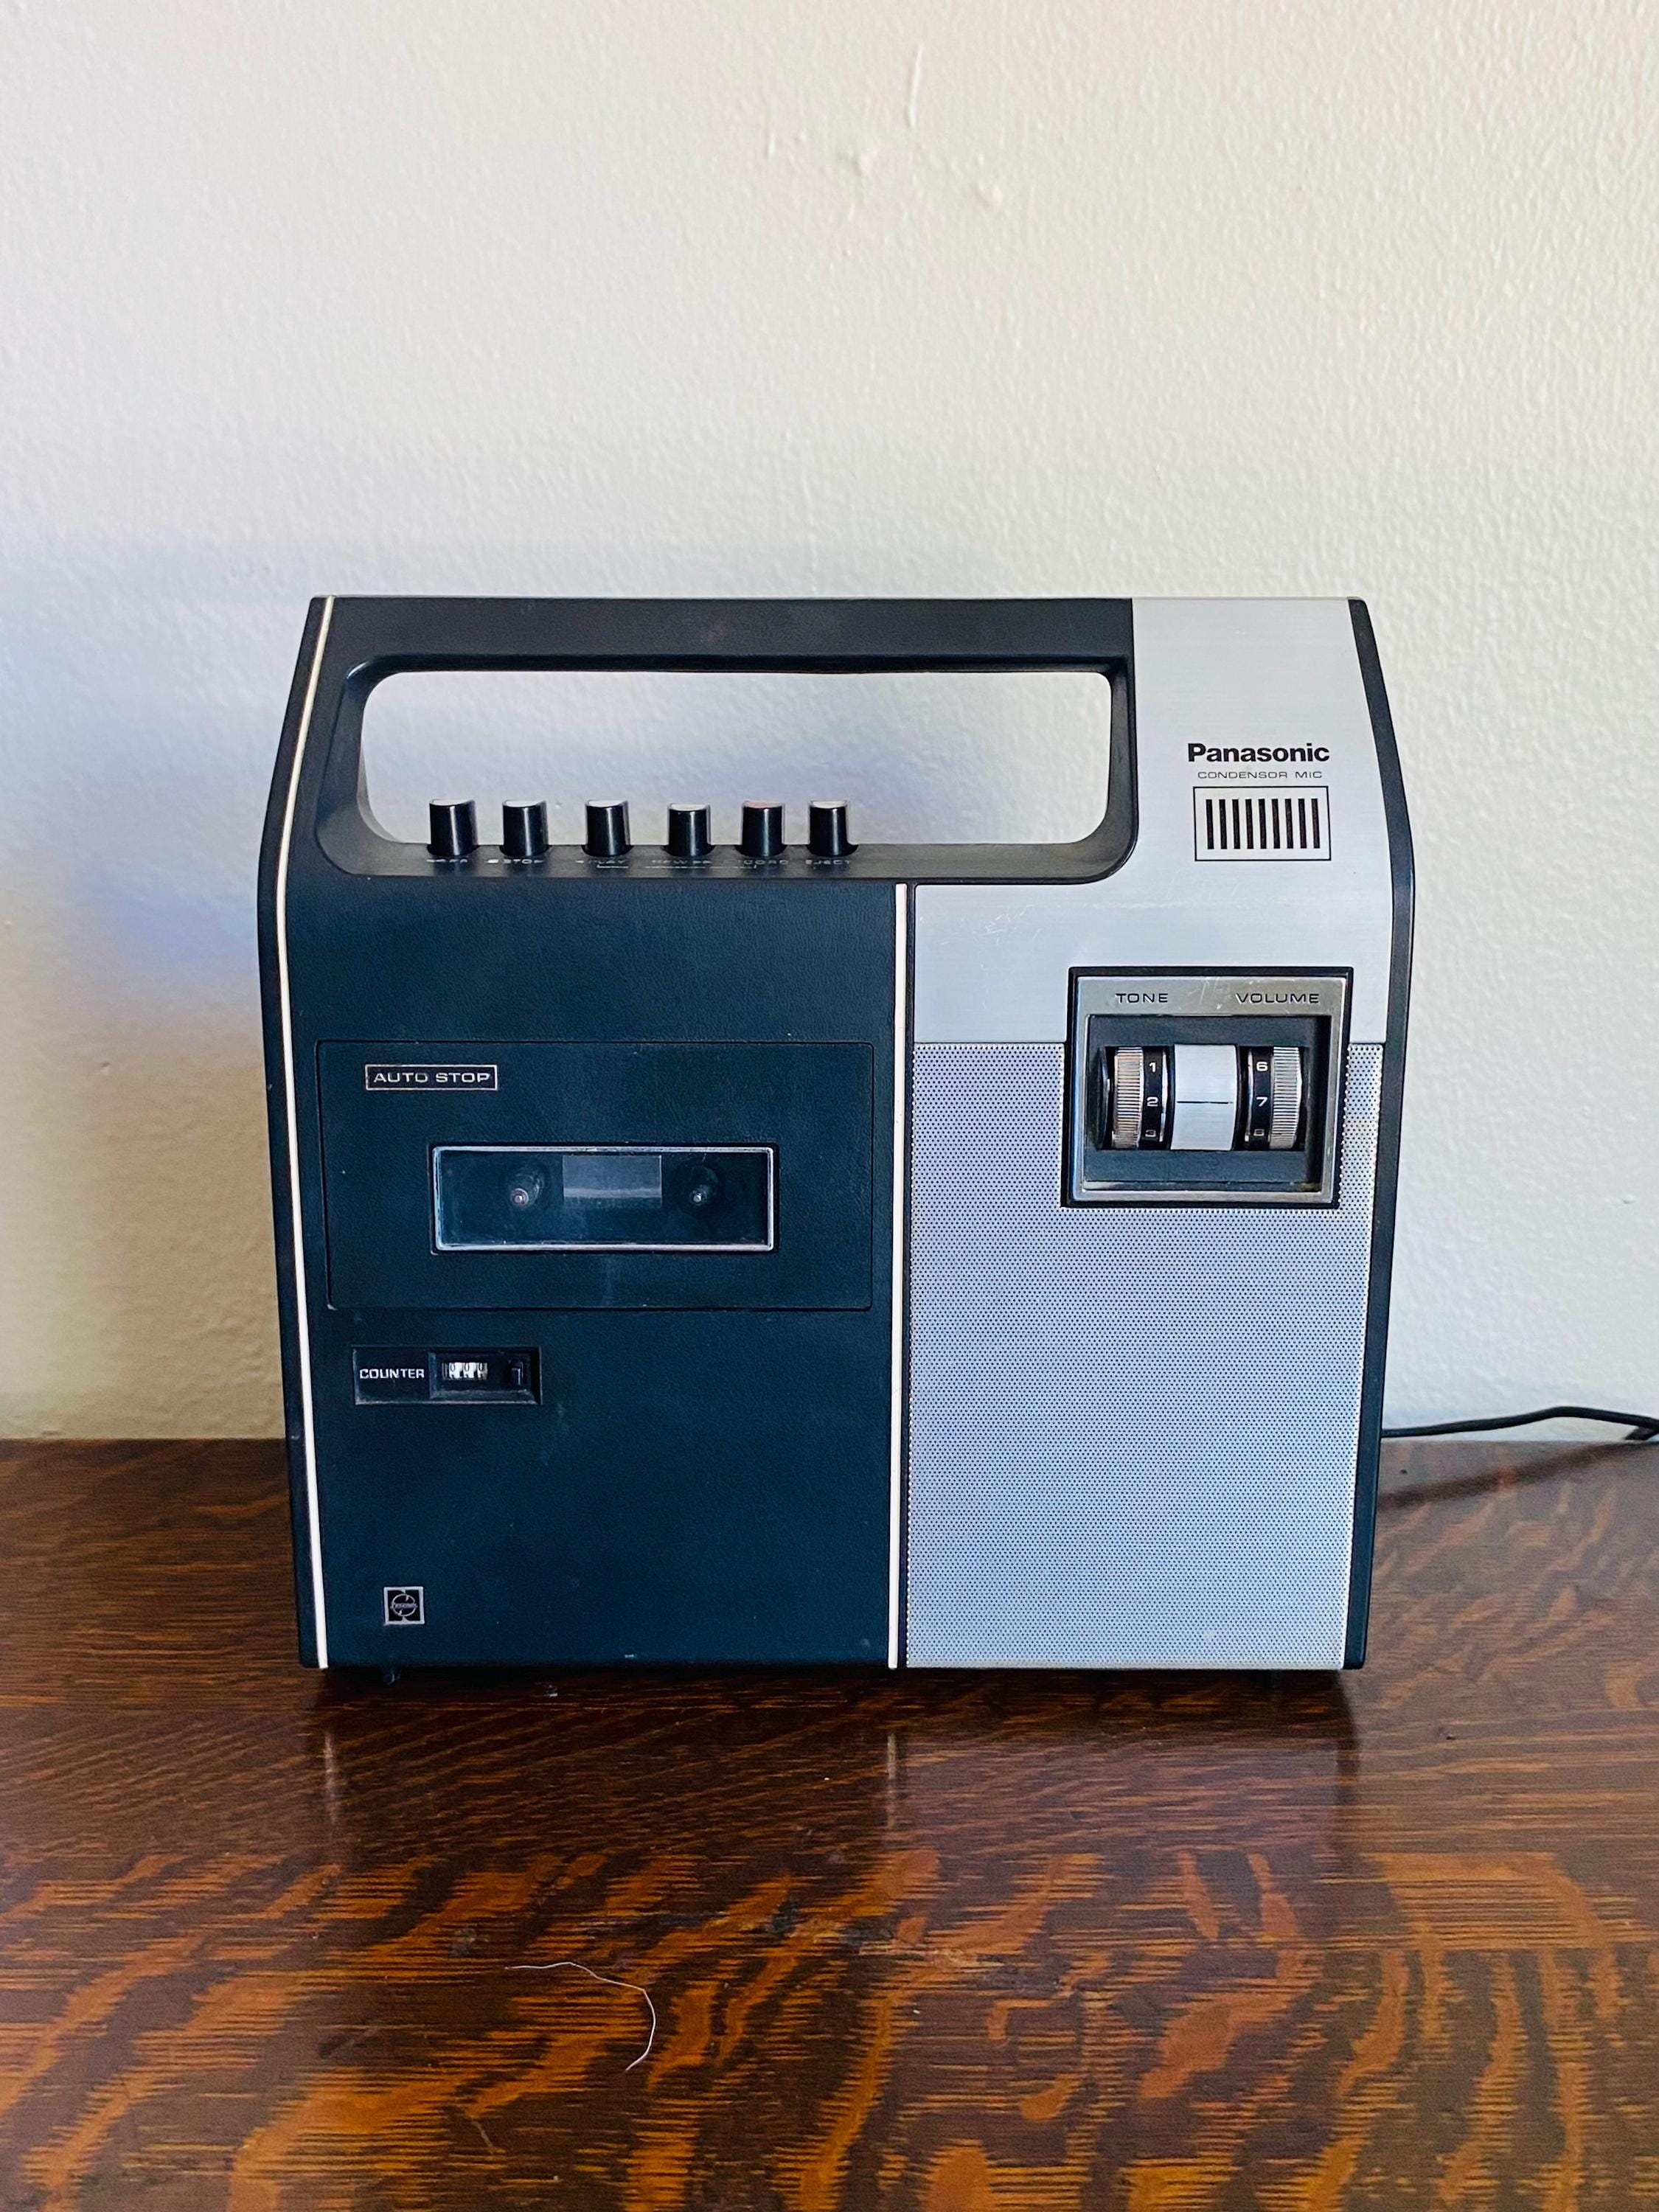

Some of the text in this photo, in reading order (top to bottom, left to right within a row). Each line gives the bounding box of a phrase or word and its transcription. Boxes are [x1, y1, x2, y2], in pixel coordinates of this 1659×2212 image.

[1188, 742, 1329, 762] Panasonic
[1115, 992, 1169, 1004] TONE
[1235, 992, 1320, 1004] VOLUME
[1149, 1062, 1156, 1073] 1
[1256, 1061, 1268, 1071] 6
[373, 1072, 490, 1083] AUTO STOP
[1147, 1096, 1158, 1107] 2
[1256, 1096, 1268, 1107] 7
[1145, 1129, 1157, 1138] 3
[359, 1368, 425, 1379] COUNTER
